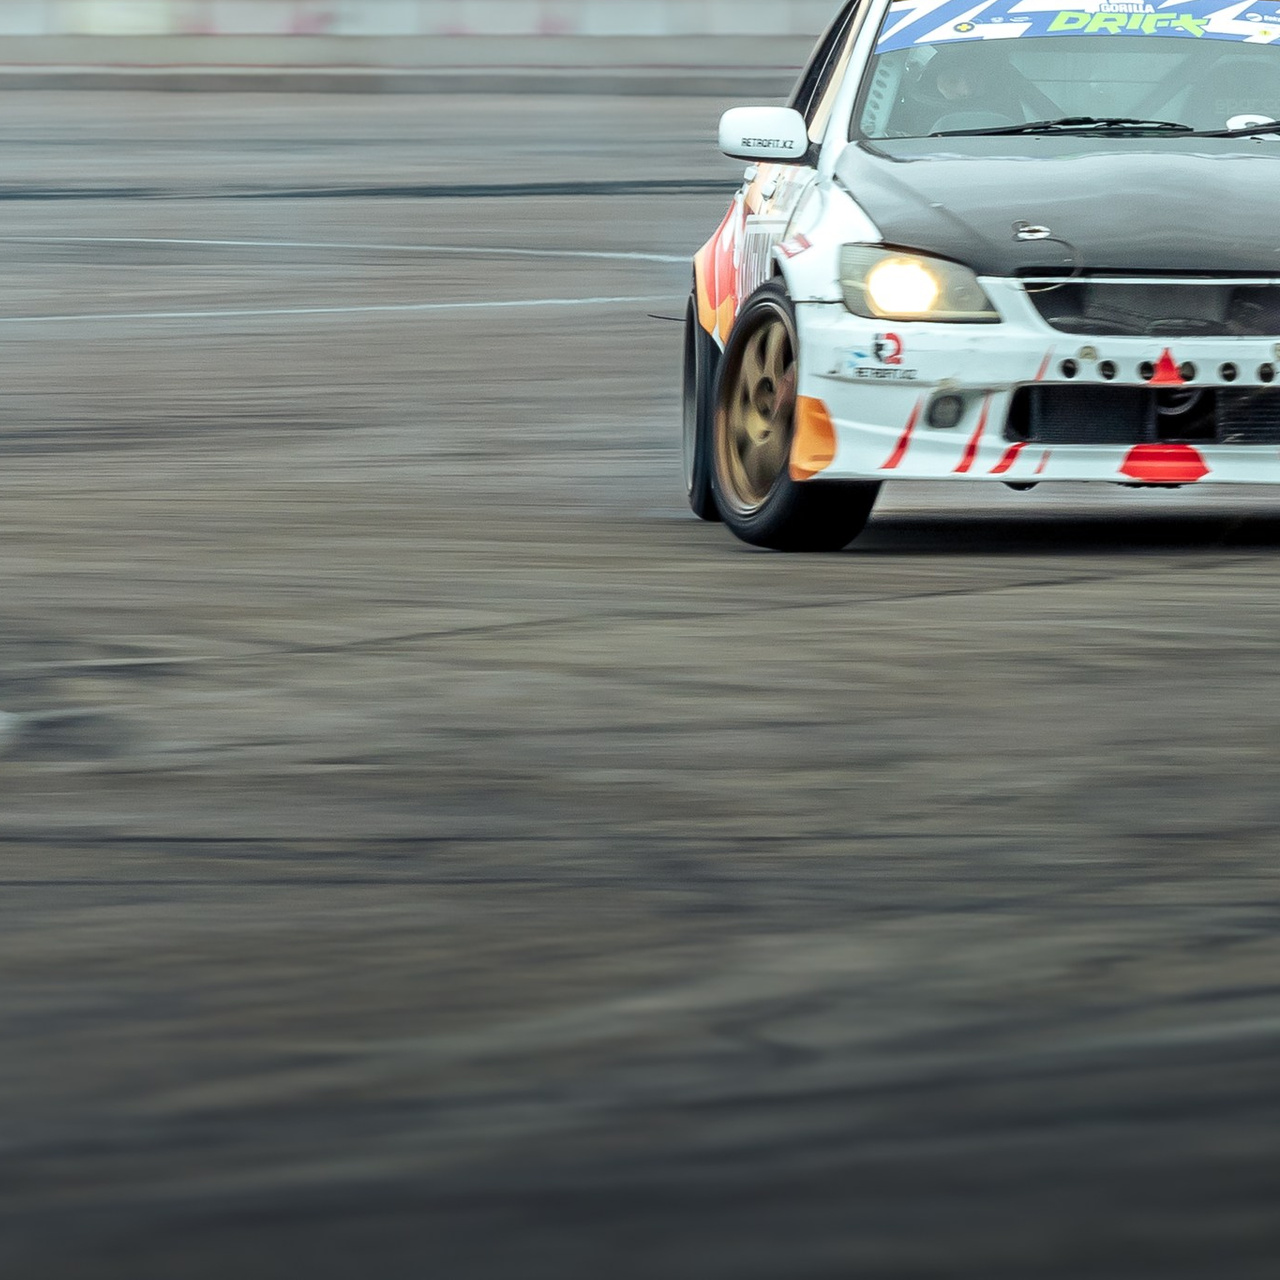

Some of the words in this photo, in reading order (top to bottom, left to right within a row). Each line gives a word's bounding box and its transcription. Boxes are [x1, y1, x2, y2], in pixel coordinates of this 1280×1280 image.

[1101, 3, 1155, 13] GORILLA
[1046, 11, 1209, 38] DRIFT
[741, 137, 794, 149] RETROFIT.KZ
